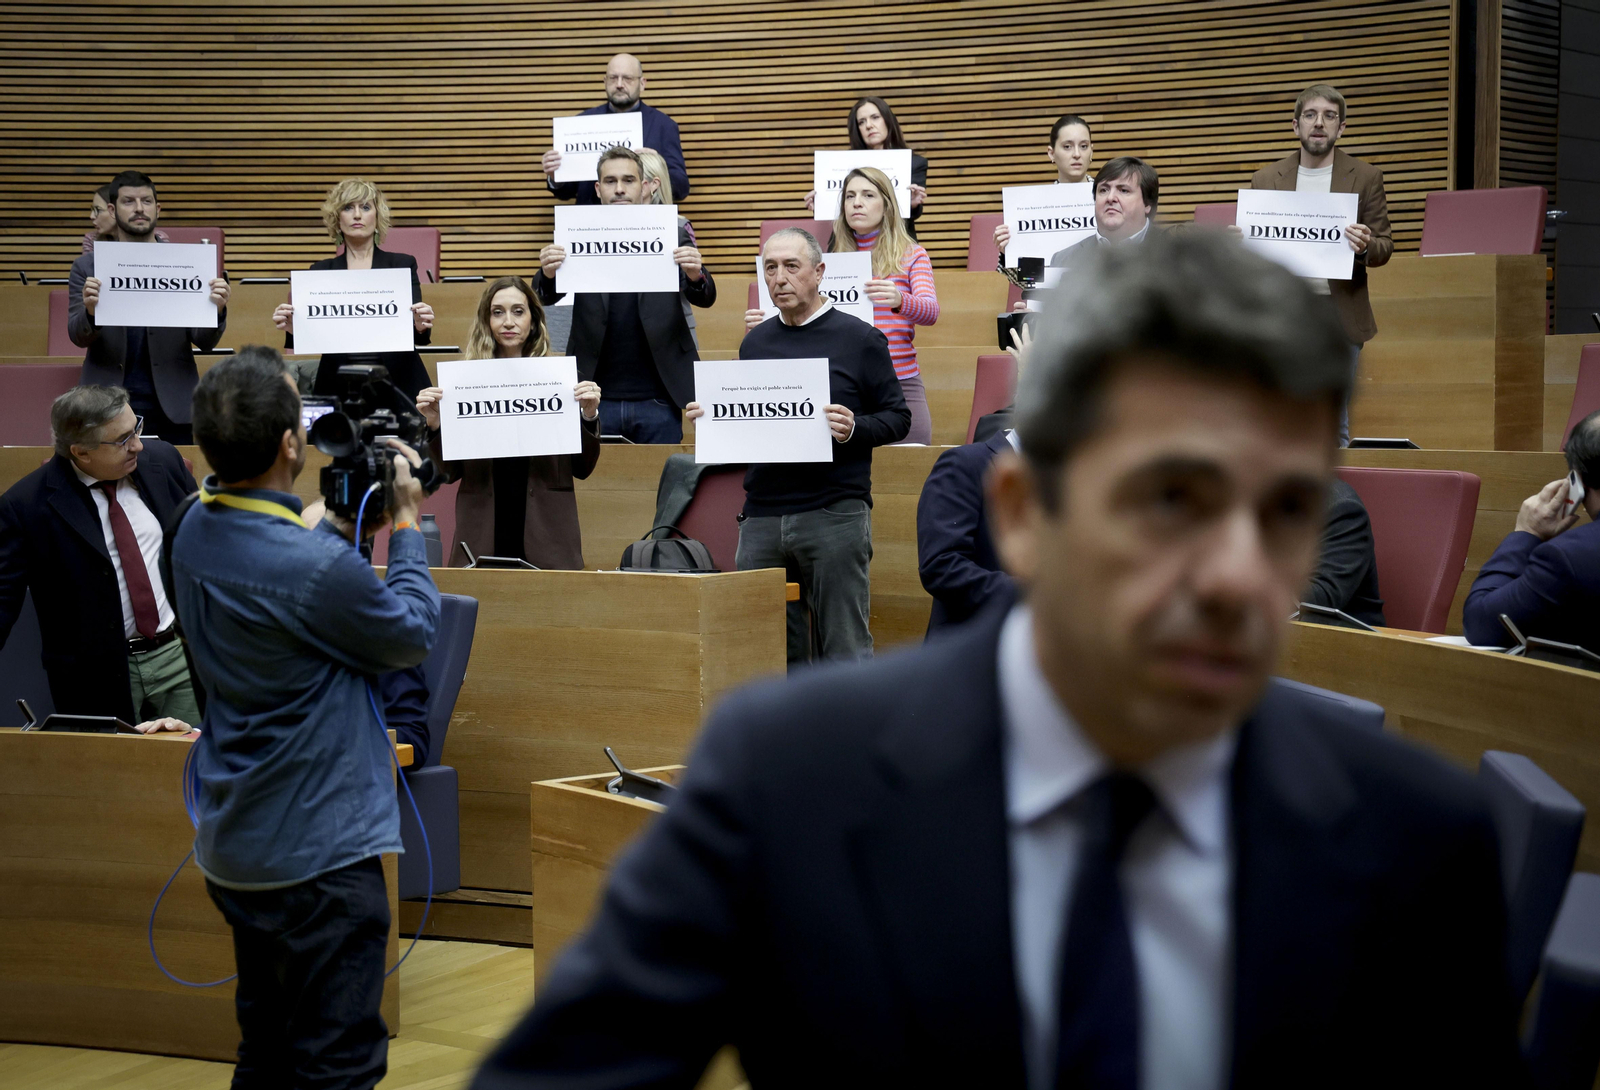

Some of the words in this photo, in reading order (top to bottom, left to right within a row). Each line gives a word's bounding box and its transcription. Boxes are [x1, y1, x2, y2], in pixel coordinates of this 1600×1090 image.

[564, 137, 632, 152] DIMISSIÓ
[1249, 225, 1341, 241] DIMISSIÓ
[570, 237, 664, 255] DIMISSIÓ
[109, 275, 203, 291] DIMISSIÓ
[307, 299, 398, 317] DIMISSIÓ
[456, 392, 563, 416] DIMISSIÓ
[712, 397, 815, 418] DIMISSIÓ
